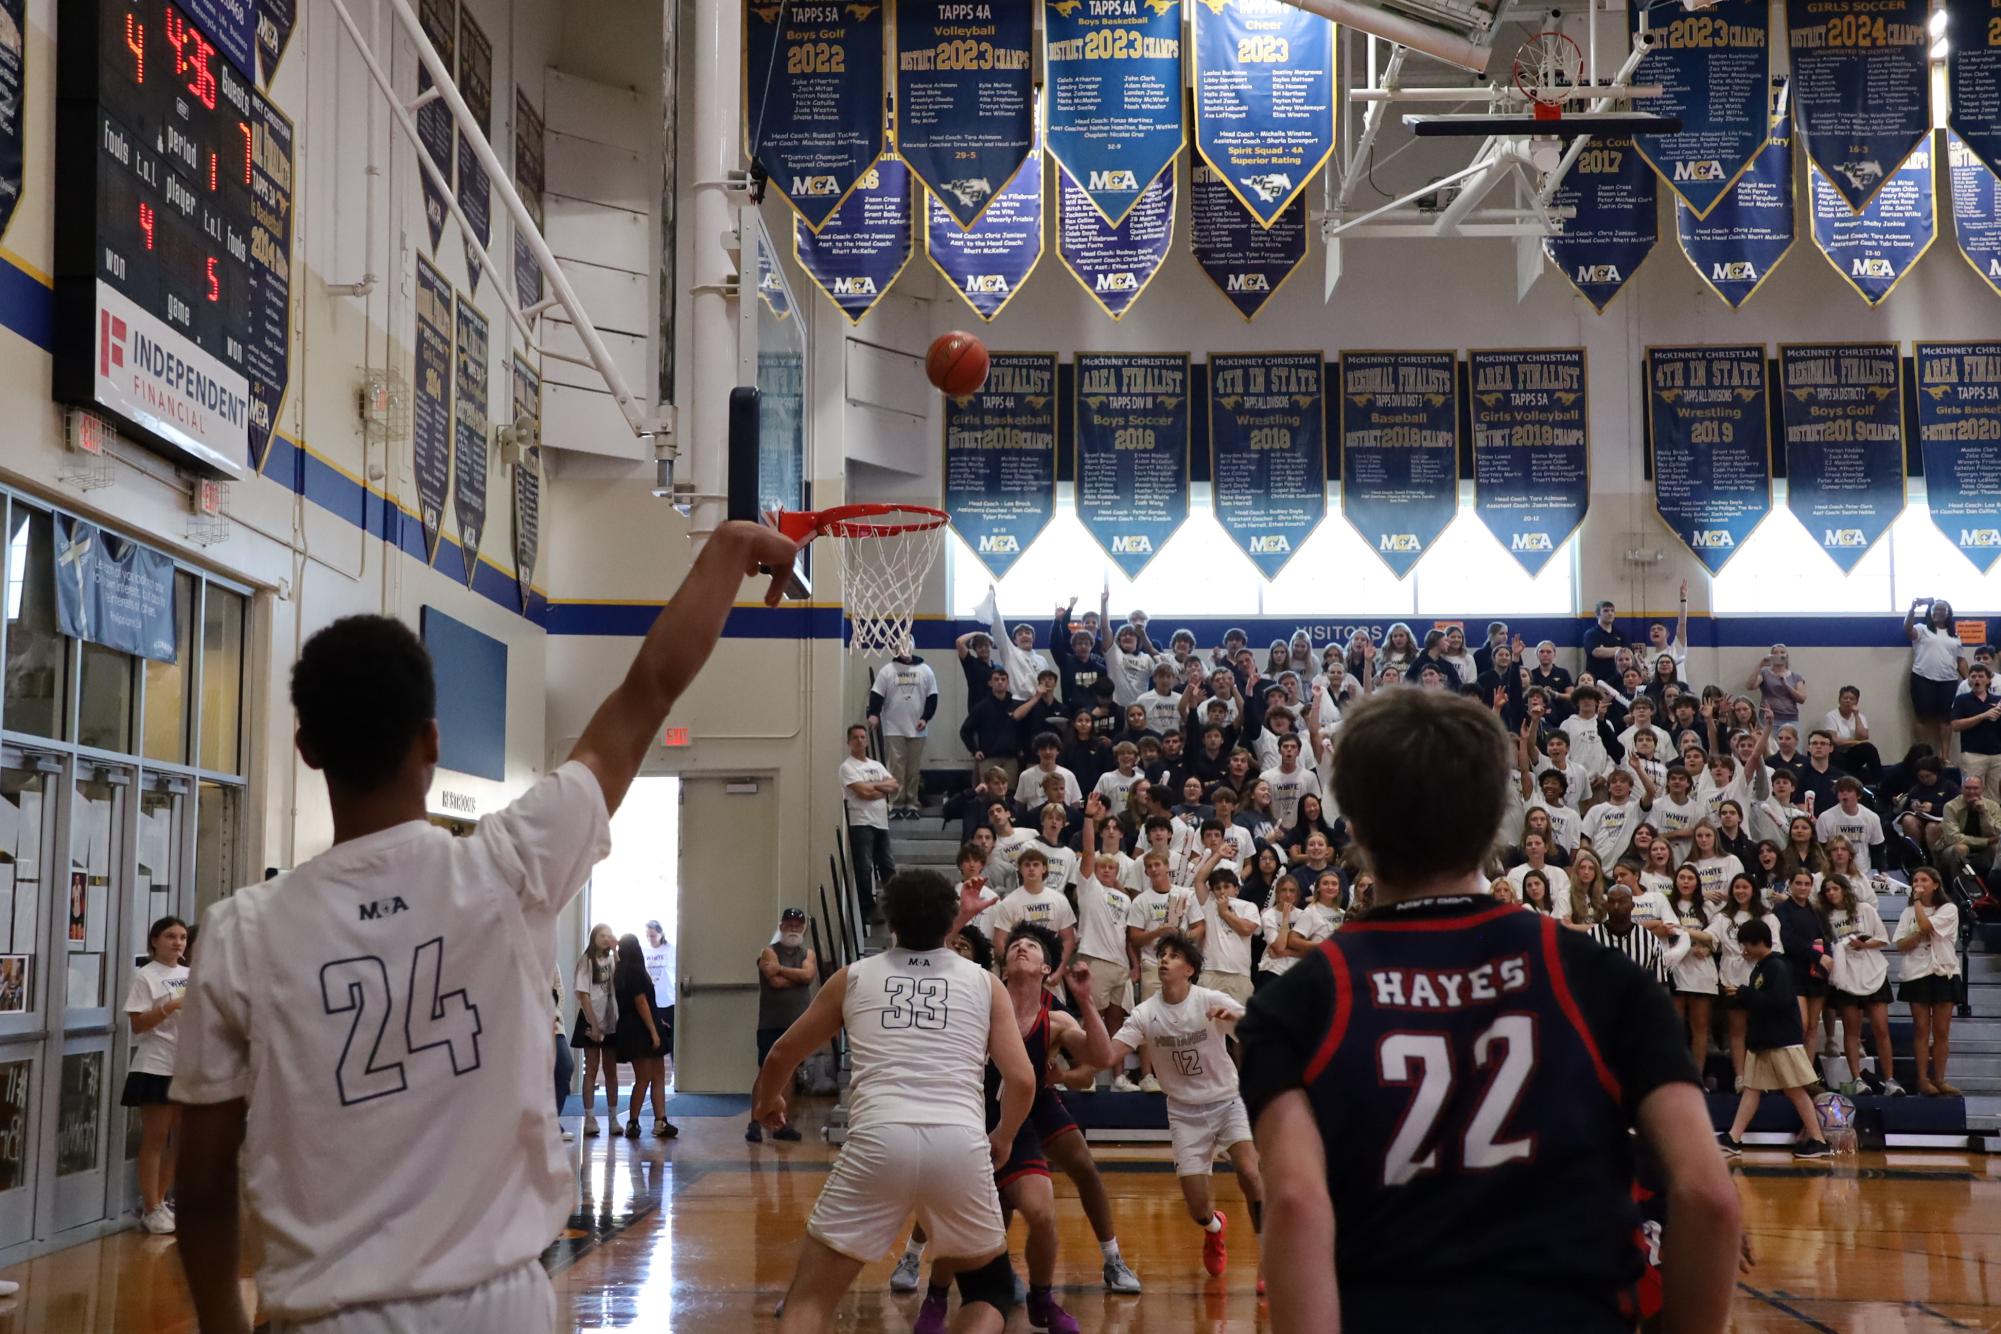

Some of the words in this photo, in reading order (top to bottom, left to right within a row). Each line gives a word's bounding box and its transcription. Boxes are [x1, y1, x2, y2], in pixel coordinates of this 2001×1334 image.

[792, 7, 822, 23] TAPPS
[825, 7, 839, 21] 5A
[938, 5, 973, 19] TAPPS
[976, 5, 991, 19] 4A
[1089, 0, 1121, 15] TAPPS
[1123, 0, 1136, 14] 4A
[1807, 1, 1849, 13] GIRLS
[1852, 0, 1906, 11] SOCCER
[1078, 18, 1099, 26] Boys
[1102, 17, 1148, 25] Basketball
[787, 30, 816, 41] Boys
[820, 29, 845, 39] Golf
[934, 26, 995, 37] Volleyball
[1669, 17, 1729, 48] 2023
[1730, 25, 1765, 47] CHAMPS
[1791, 25, 1827, 48] DISTRICT
[1828, 15, 1886, 46] 2024
[1887, 24, 1925, 46] CHAMPS
[127, 13, 143, 84] 4
[1048, 39, 1083, 60] DISTRICT
[1085, 29, 1143, 59] 2023
[1144, 37, 1178, 58] CHAMPS
[1238, 35, 1288, 63] 2023
[787, 42, 845, 74] 2022
[936, 40, 993, 70] 2023
[994, 48, 1029, 69] CHAMPS
[221, 65, 250, 117] Guests
[104, 120, 129, 165] Fouls
[168, 125, 197, 169] period
[1231, 157, 1268, 165] Superior
[1271, 157, 1301, 165] Rating
[1578, 150, 1622, 173] 2017
[1088, 170, 1139, 190] MCA
[1674, 161, 1726, 181] MCA
[791, 175, 841, 195] MCA
[166, 174, 196, 216] player
[227, 225, 247, 262] Fouls
[106, 247, 126, 281] won
[1577, 264, 1621, 282] MCA
[1712, 262, 1757, 281] MCA
[1852, 259, 1895, 276] MCA
[207, 256, 219, 301] 5
[833, 277, 877, 293] MCA
[966, 275, 1009, 291] MCA
[1096, 272, 1138, 291] MCA
[1227, 274, 1270, 290] MCA
[168, 292, 190, 327] game
[227, 336, 243, 364] won
[1787, 349, 1836, 357] McKINNEY
[1839, 348, 1893, 356] CHRISTIAN
[1082, 358, 1129, 366] McKINNEY
[1215, 358, 1262, 366] McKINNEY
[1265, 357, 1316, 365] CHRISTIAN
[1348, 356, 1395, 364] McKINNEY
[134, 330, 246, 430] INDEPENDENT
[991, 367, 1050, 393] FINALIST
[1082, 368, 1117, 393] AREA
[1122, 367, 1183, 393] FINALIST
[1216, 368, 1244, 393] 4TH
[1249, 368, 1264, 393] IN
[1270, 367, 1317, 393] STATE
[1399, 367, 1450, 393] FINALISTS
[1477, 366, 1513, 391] AREA
[1517, 364, 1579, 390] FINALIST
[1656, 362, 1684, 387] 4TH
[1690, 361, 1706, 386] IN
[1712, 361, 1760, 386] STATE
[1841, 357, 1895, 384] FINALISTS
[1924, 357, 1958, 384] AREA
[1511, 393, 1536, 406] TAPPS
[1537, 393, 1549, 405] 5A
[1957, 387, 1986, 400] TAPPS
[1987, 386, 1999, 400] 5A
[134, 375, 205, 435] FINANCIAL
[1677, 407, 1742, 419] Wrestling
[1811, 406, 1843, 418] Boys
[1847, 405, 1876, 415] Golf
[1936, 406, 1962, 415] Girls
[952, 416, 980, 425] Girls
[984, 415, 1050, 425] Basketball
[1093, 415, 1124, 426] Boys
[1129, 415, 1173, 425] Soccer
[1236, 415, 1300, 427] Wrestling
[1371, 412, 1427, 423] Baseball
[1481, 412, 1511, 422] Girls
[1514, 410, 1579, 423] Volleyball
[1115, 428, 1155, 449] 2018
[1250, 428, 1290, 449] 2018
[1691, 421, 1734, 443] 2019
[1957, 418, 2001, 441] 2020
[978, 535, 1020, 552] MCA
[1112, 535, 1152, 552] MCA
[1249, 535, 1290, 552] MCA
[1380, 534, 1421, 551] MCA
[1511, 533, 1553, 550] MCA
[1692, 530, 1735, 547] MCA
[1824, 529, 1867, 545] MCA
[1665, 812, 1689, 823] WHITE
[1840, 826, 1864, 834] WHITE
[1698, 867, 1722, 876] WHITE
[1026, 904, 1051, 912] WHITE
[1371, 956, 1527, 1008] HAYES
[881, 975, 948, 1030] 33
[319, 934, 482, 1107] 24
[1172, 1048, 1203, 1076] 12
[1379, 1014, 1535, 1187] 22
